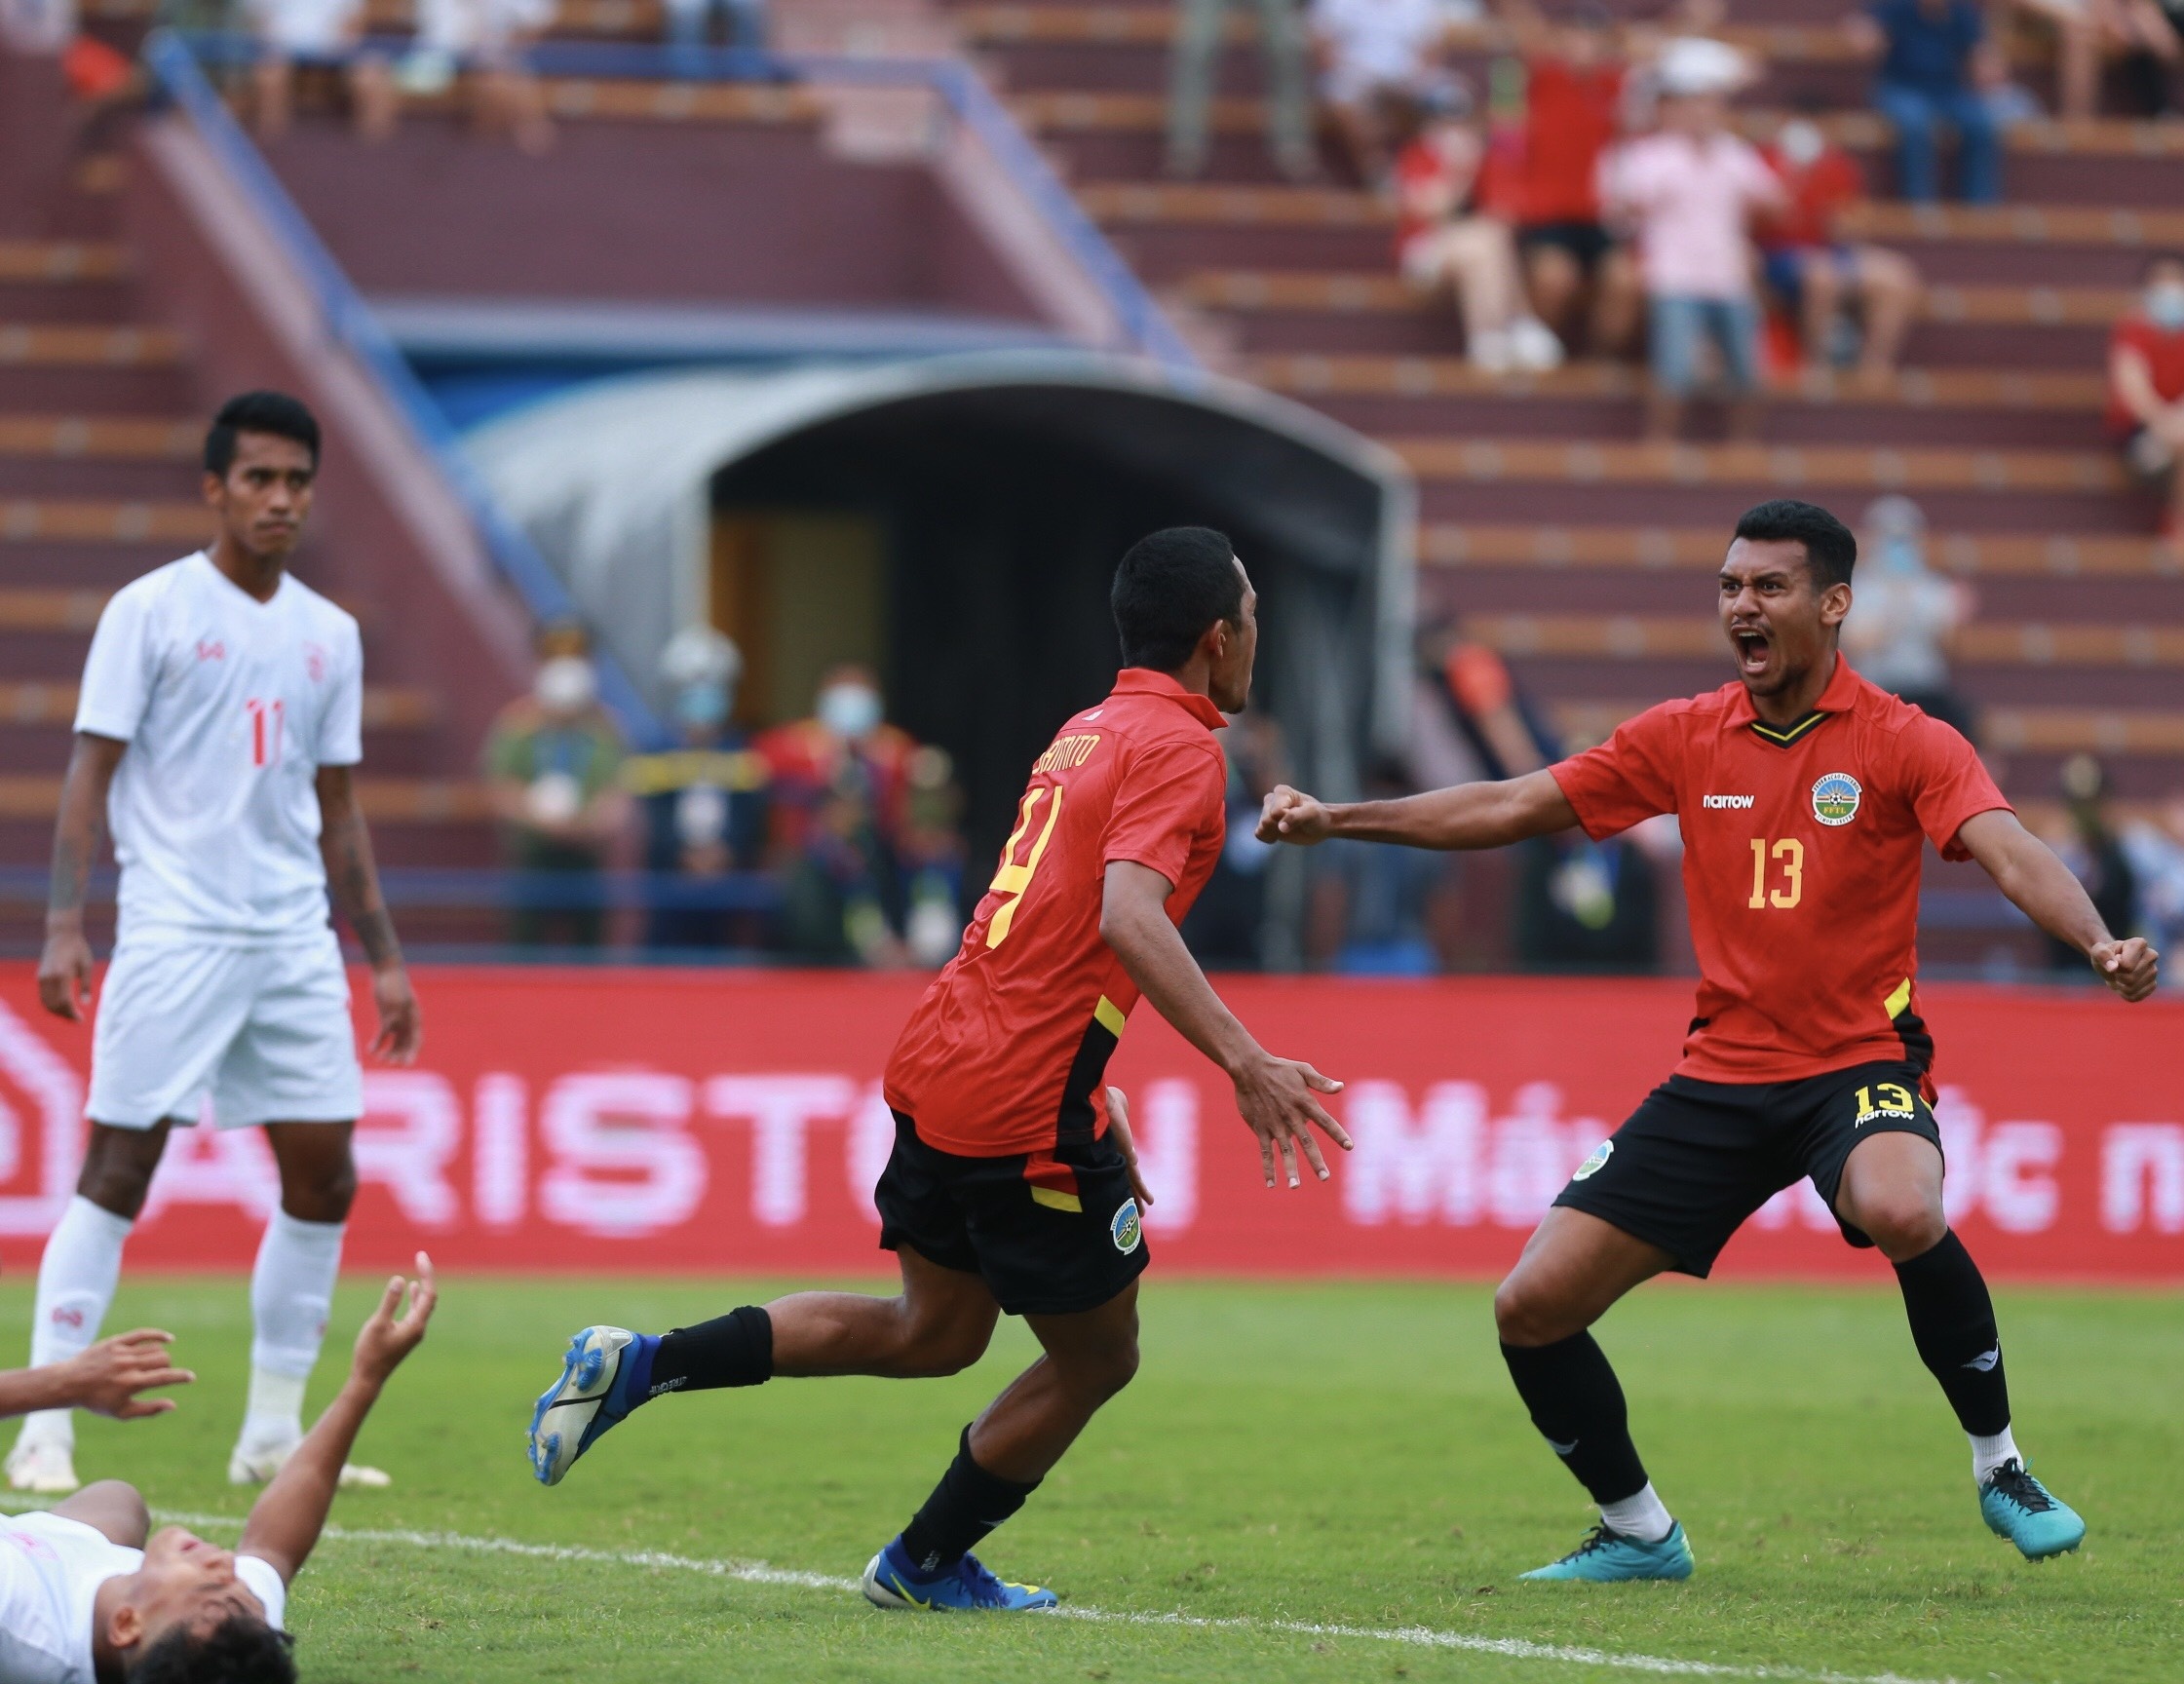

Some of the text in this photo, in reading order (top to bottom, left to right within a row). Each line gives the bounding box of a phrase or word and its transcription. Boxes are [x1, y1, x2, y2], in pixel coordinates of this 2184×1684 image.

[1704, 795, 1754, 809] narrow
[986, 785, 1063, 950] 4
[1748, 838, 1803, 909] 13
[1855, 1083, 1914, 1119] 13
[1855, 1110, 1915, 1129] narrow
